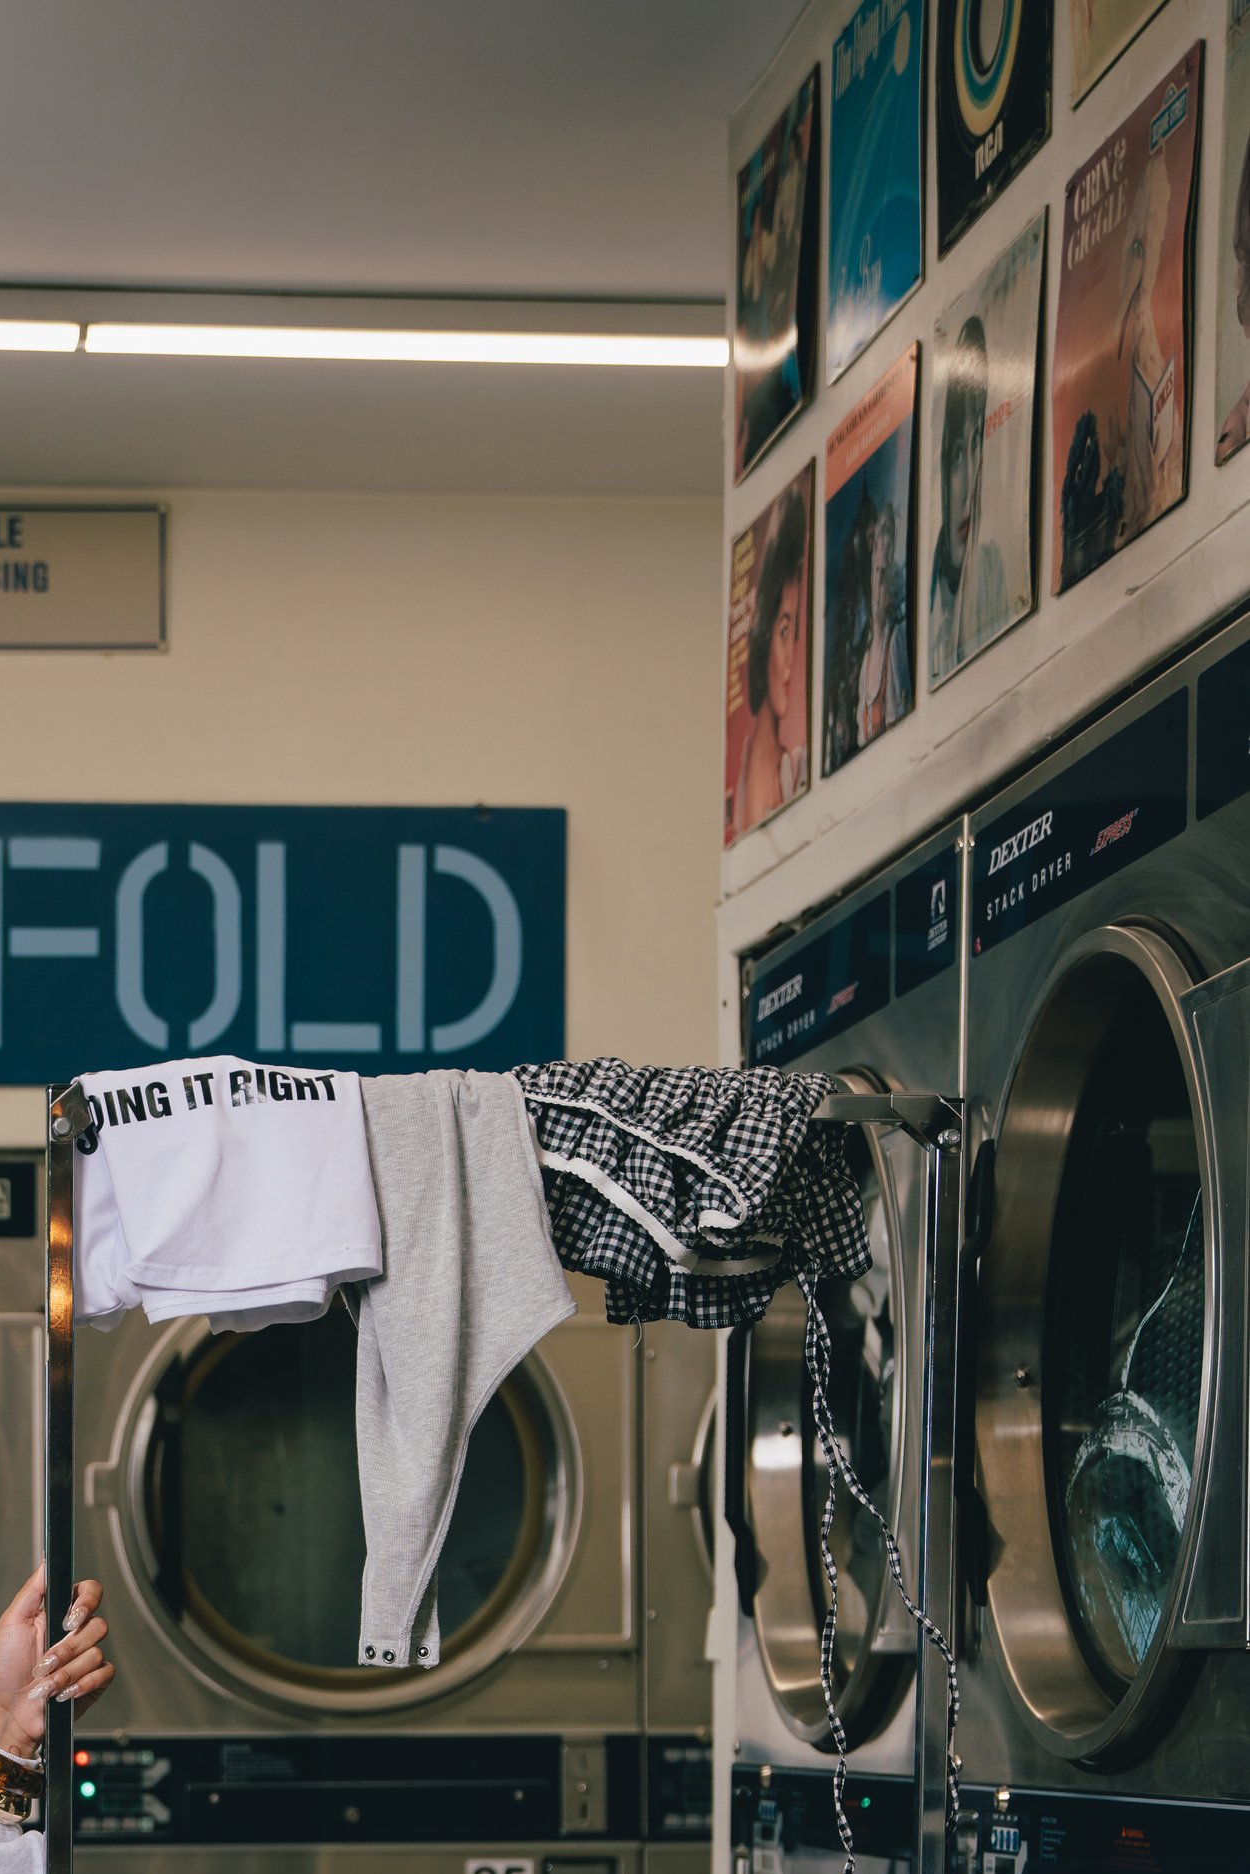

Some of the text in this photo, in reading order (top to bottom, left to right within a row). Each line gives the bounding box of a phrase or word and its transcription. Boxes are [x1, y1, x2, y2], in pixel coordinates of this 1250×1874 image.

[974, 121, 1003, 181] RCA
[1074, 137, 1127, 223] GRIN &
[1067, 180, 1128, 271] GIGGLE
[988, 811, 1136, 876] DEXTER EXPRESS
[986, 852, 1072, 921] STACK DRYER
[757, 974, 803, 1022] DEXTER
[182, 1072, 214, 1111] IT
[229, 1068, 337, 1108] RIGHT
